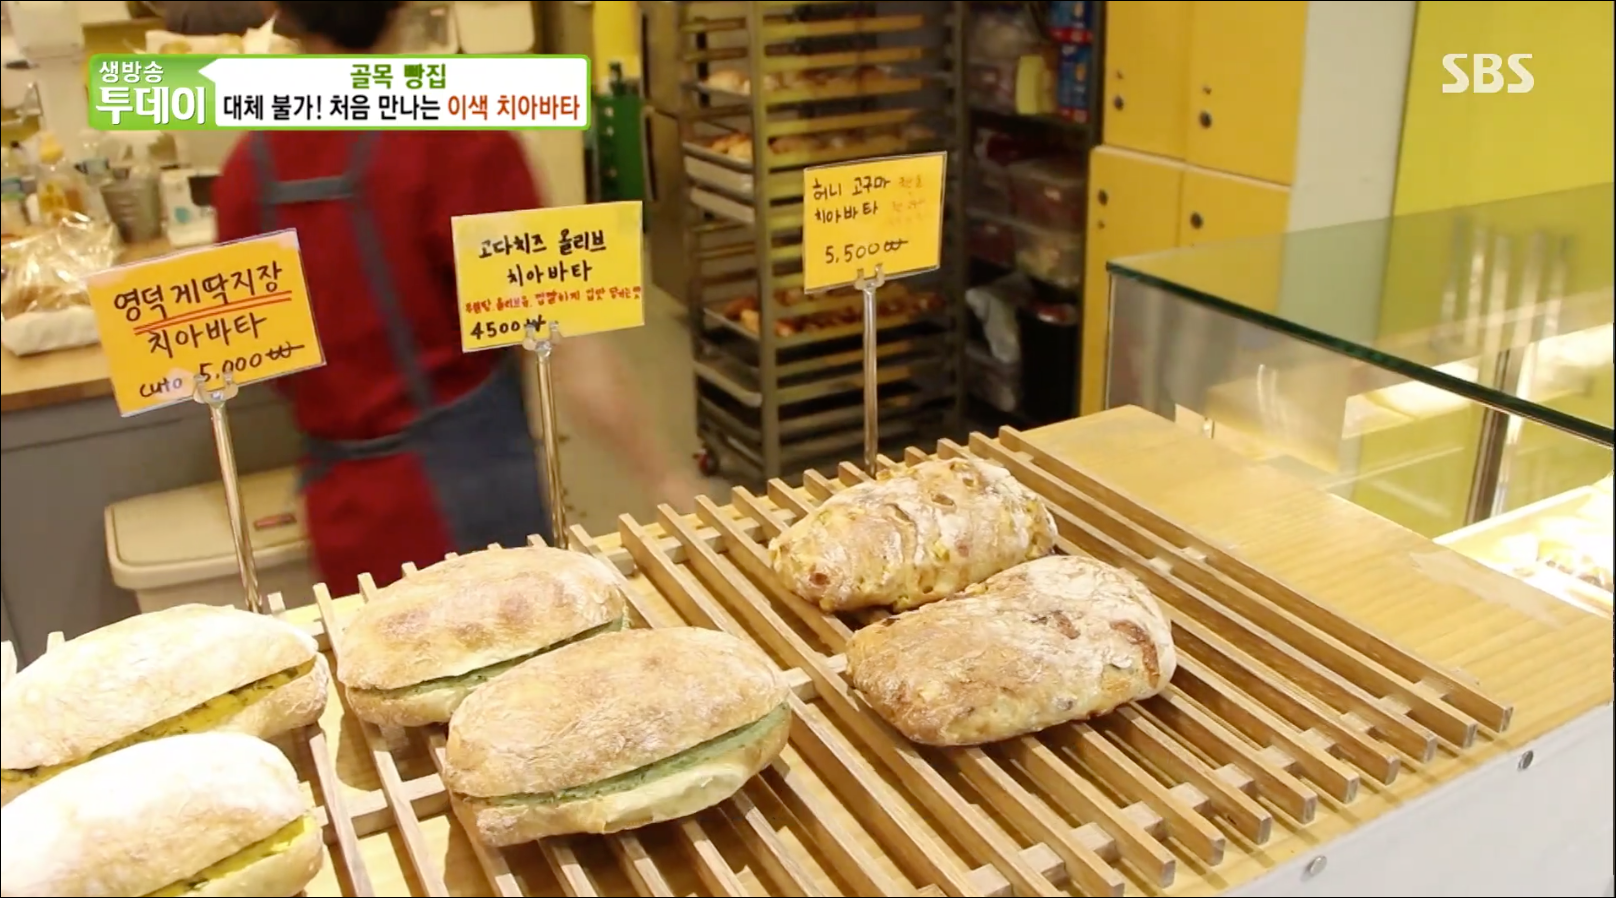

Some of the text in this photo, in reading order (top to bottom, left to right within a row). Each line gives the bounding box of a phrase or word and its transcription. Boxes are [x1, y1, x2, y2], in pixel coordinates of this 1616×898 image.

[812, 178, 842, 200] 허니
[852, 175, 891, 196] 고구마
[814, 201, 879, 223] 치아바타
[478, 228, 607, 258] 고다치즈 올리브
[507, 259, 592, 287] 치아바타
[113, 285, 169, 322] 영덕
[148, 312, 267, 359] 치아바타
